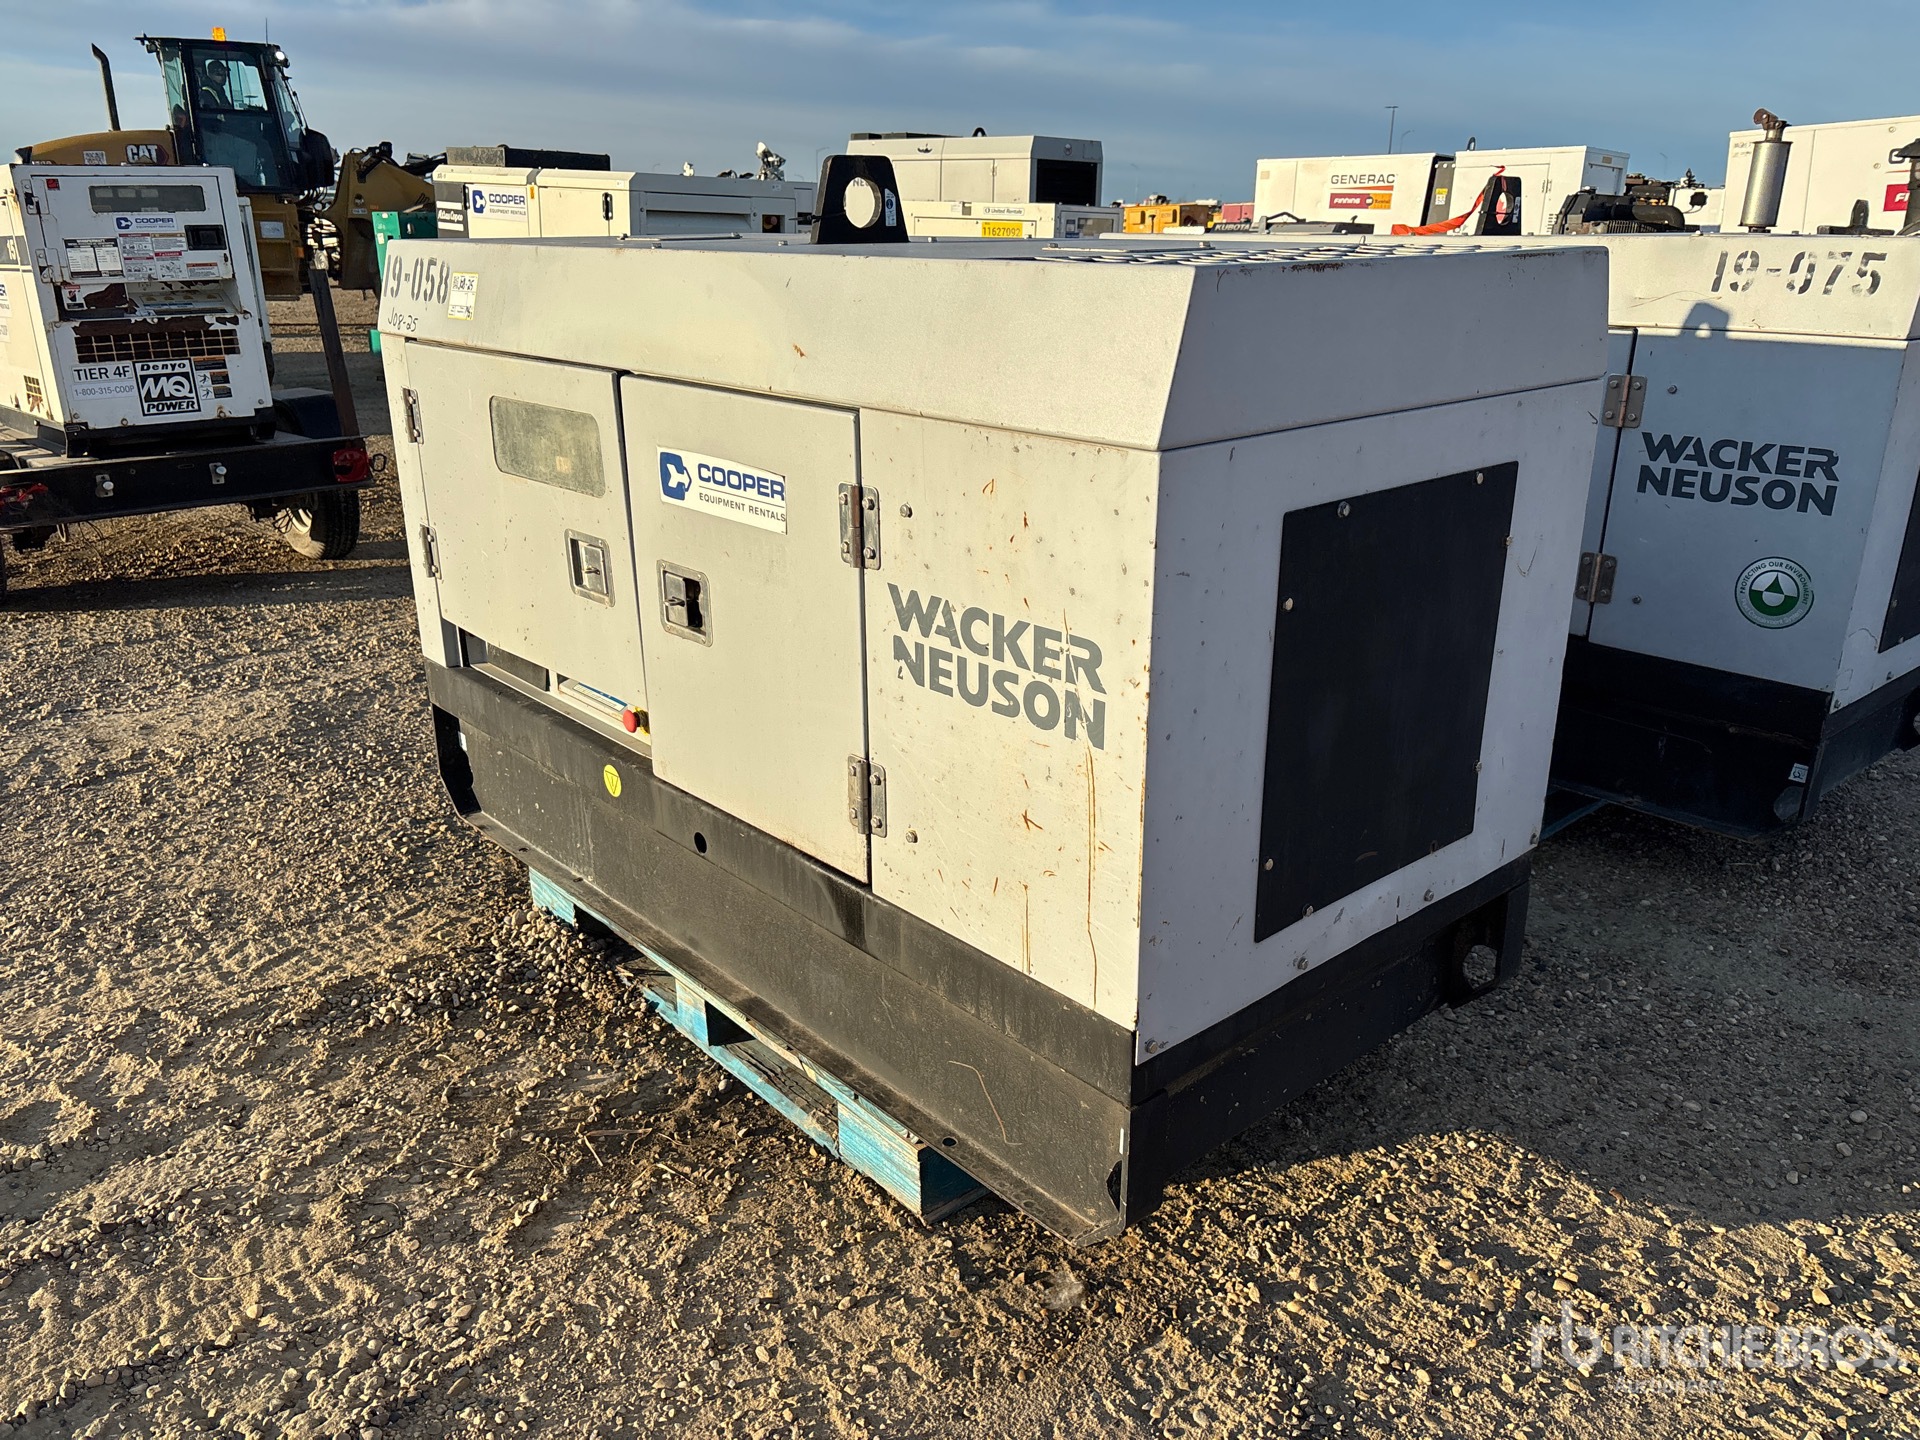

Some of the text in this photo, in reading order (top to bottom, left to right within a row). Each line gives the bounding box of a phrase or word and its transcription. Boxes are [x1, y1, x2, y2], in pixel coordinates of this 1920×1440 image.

[126, 144, 158, 163] CAT
[1330, 174, 1396, 184] GENERAC
[488, 193, 526, 206] COOPER
[982, 226, 1022, 237] 11627092
[1214, 223, 1251, 231] KUBOTA
[383, 254, 451, 304] 19-058
[1711, 250, 1888, 297] 19-075
[74, 365, 130, 381] TIER 4F
[140, 362, 186, 372] Denyo
[142, 375, 195, 399] MQ
[146, 400, 195, 413] POWER
[1641, 431, 1840, 482] WACKER
[697, 463, 785, 501] COOPER
[1636, 465, 1838, 517] NEUSON
[699, 492, 786, 522] EQUIPMENT RENTALS
[1740, 562, 1767, 594] PROTECTING
[1784, 564, 1810, 605] ENVIRONMENT
[887, 582, 1107, 695] WACKER
[893, 634, 1106, 751] NEUSON
